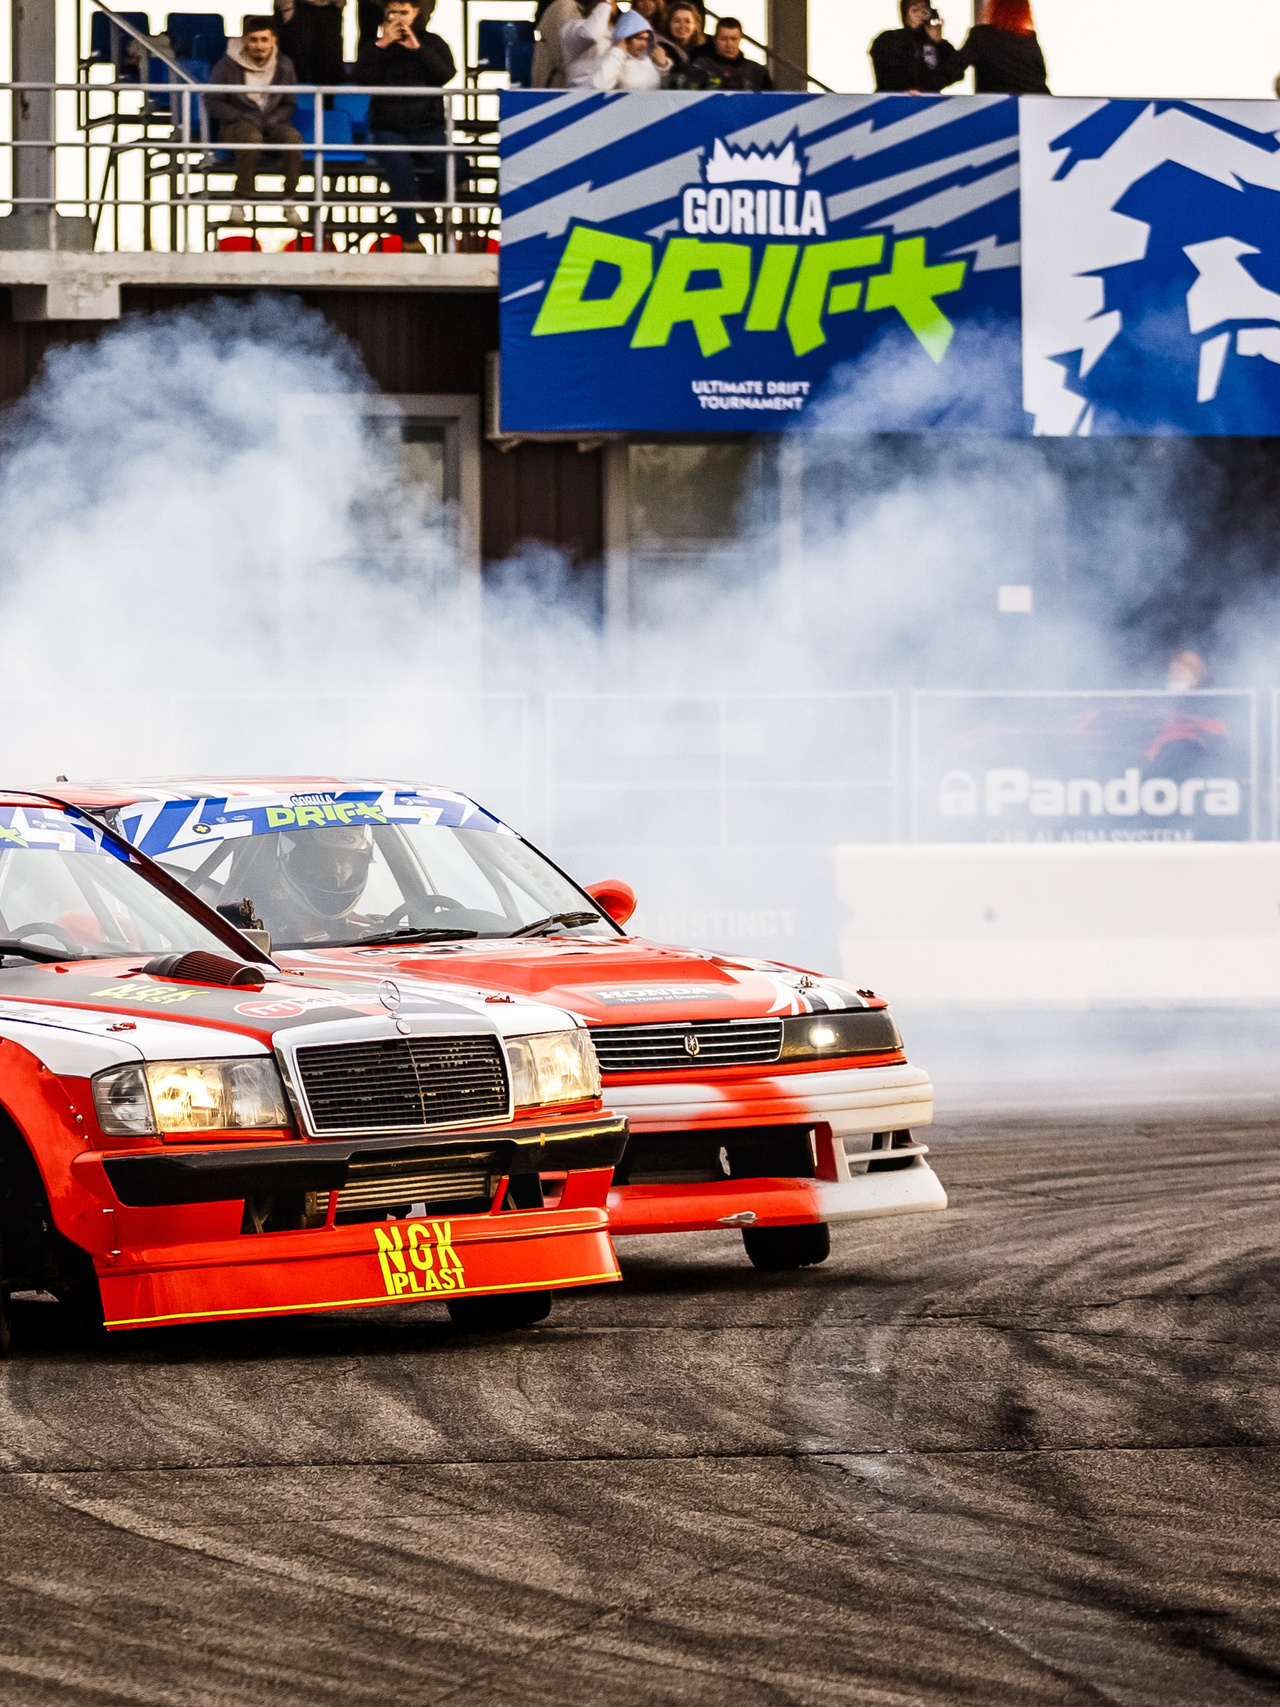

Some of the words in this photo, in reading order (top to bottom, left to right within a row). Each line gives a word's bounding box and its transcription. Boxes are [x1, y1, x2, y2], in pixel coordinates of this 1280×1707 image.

[682, 187, 826, 236] GORILLA
[531, 224, 967, 366] DRIFT
[691, 380, 763, 395] ULTIMATE
[766, 381, 810, 396] DRIFT
[698, 395, 803, 411] TOURNAMENT
[291, 794, 337, 807] GORILLA
[984, 767, 1241, 817] Pandora
[265, 802, 388, 828] DRIFT
[596, 988, 718, 1000] HONDA
[373, 1221, 463, 1295] NGK
[392, 1267, 466, 1295] PLAST
